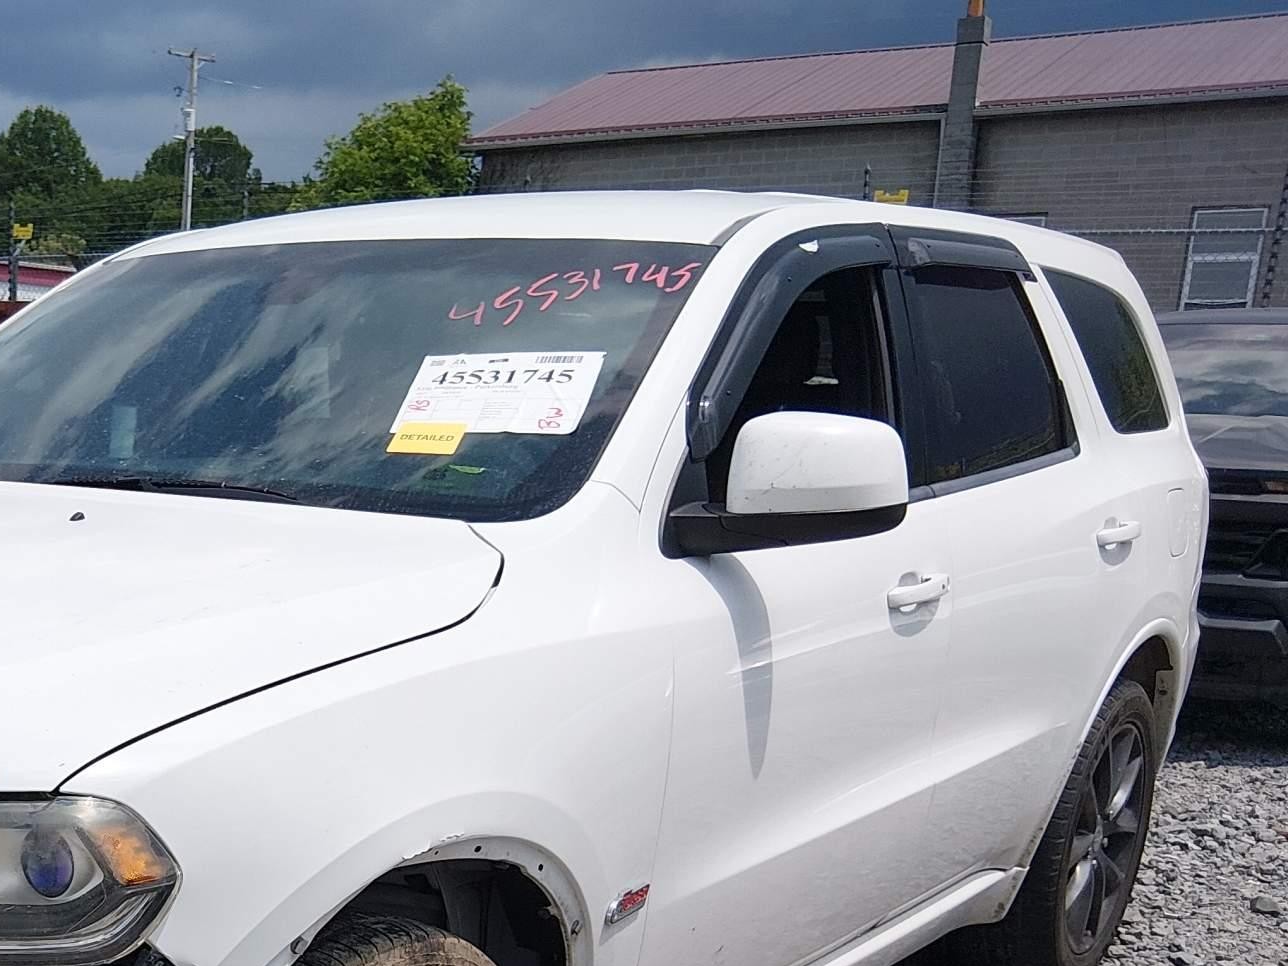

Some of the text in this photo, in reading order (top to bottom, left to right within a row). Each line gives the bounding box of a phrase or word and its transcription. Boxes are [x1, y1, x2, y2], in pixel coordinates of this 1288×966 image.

[448, 262, 703, 327] 45531745
[431, 368, 576, 386] 45531745
[398, 432, 456, 442] DETAILED
